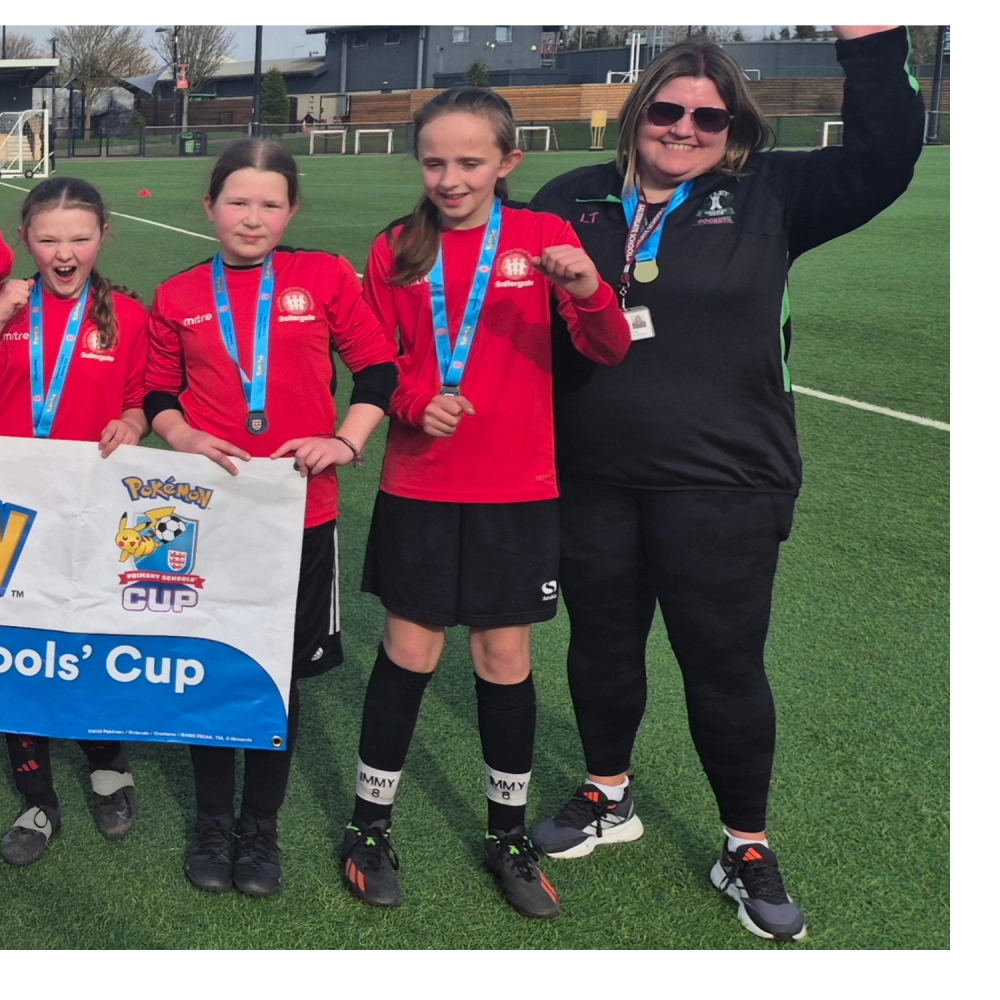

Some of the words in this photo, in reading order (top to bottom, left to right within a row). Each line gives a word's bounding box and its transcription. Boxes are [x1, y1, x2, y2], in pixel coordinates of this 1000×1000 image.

[183, 313, 213, 326] mitre
[3, 331, 30, 341] mitre
[126, 572, 160, 580] PRIMARY
[122, 586, 198, 613] CUP
[105, 645, 205, 693] Cup
[371, 788, 380, 798] 8
[502, 791, 511, 800] 8
